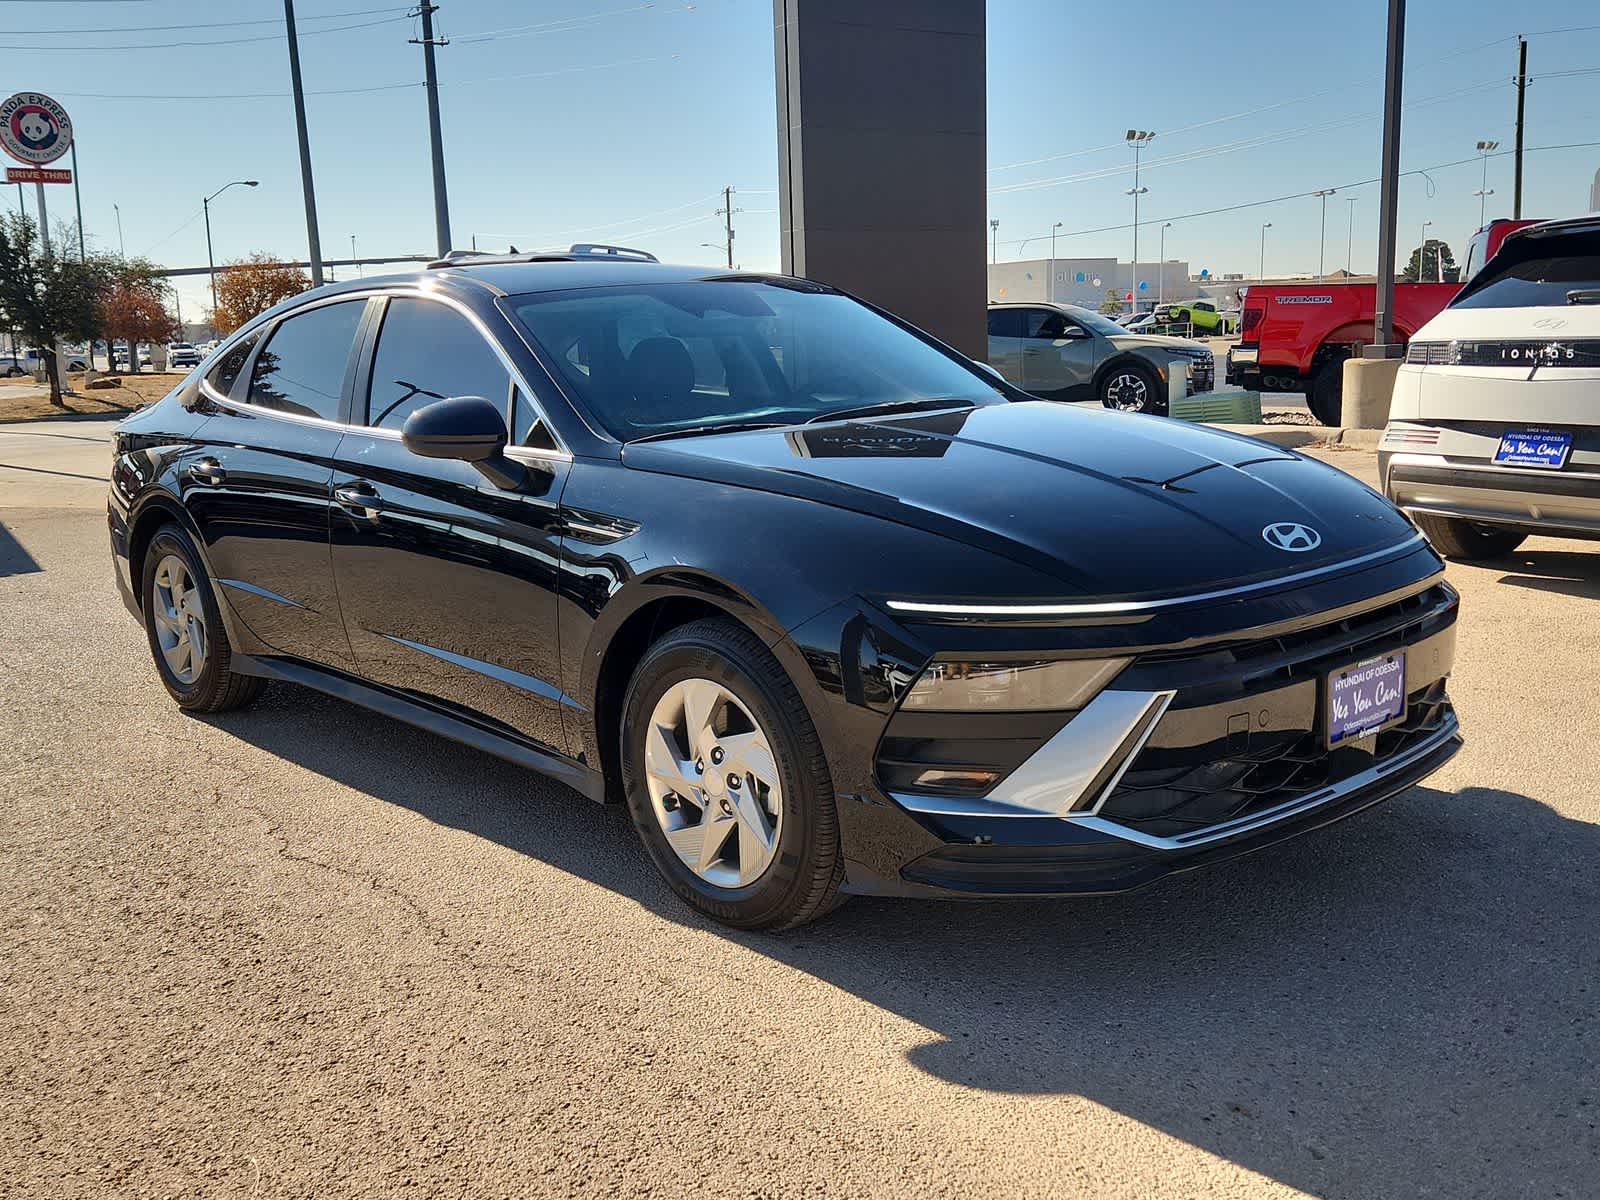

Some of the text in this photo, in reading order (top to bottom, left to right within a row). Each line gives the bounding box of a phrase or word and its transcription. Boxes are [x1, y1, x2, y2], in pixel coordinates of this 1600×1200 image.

[0, 95, 69, 129] PANDA EXPRESS
[8, 170, 71, 180] DRIVE THRU
[1275, 295, 1333, 304] TREMOR
[1508, 433, 1533, 441] HYUNDAI
[1500, 439, 1564, 457] Yes You Can!
[1335, 671, 1365, 692] HYUNDAI
[1365, 667, 1375, 682] OF
[1375, 661, 1400, 677] ODESSA
[1332, 673, 1402, 723] Yes You Can!
